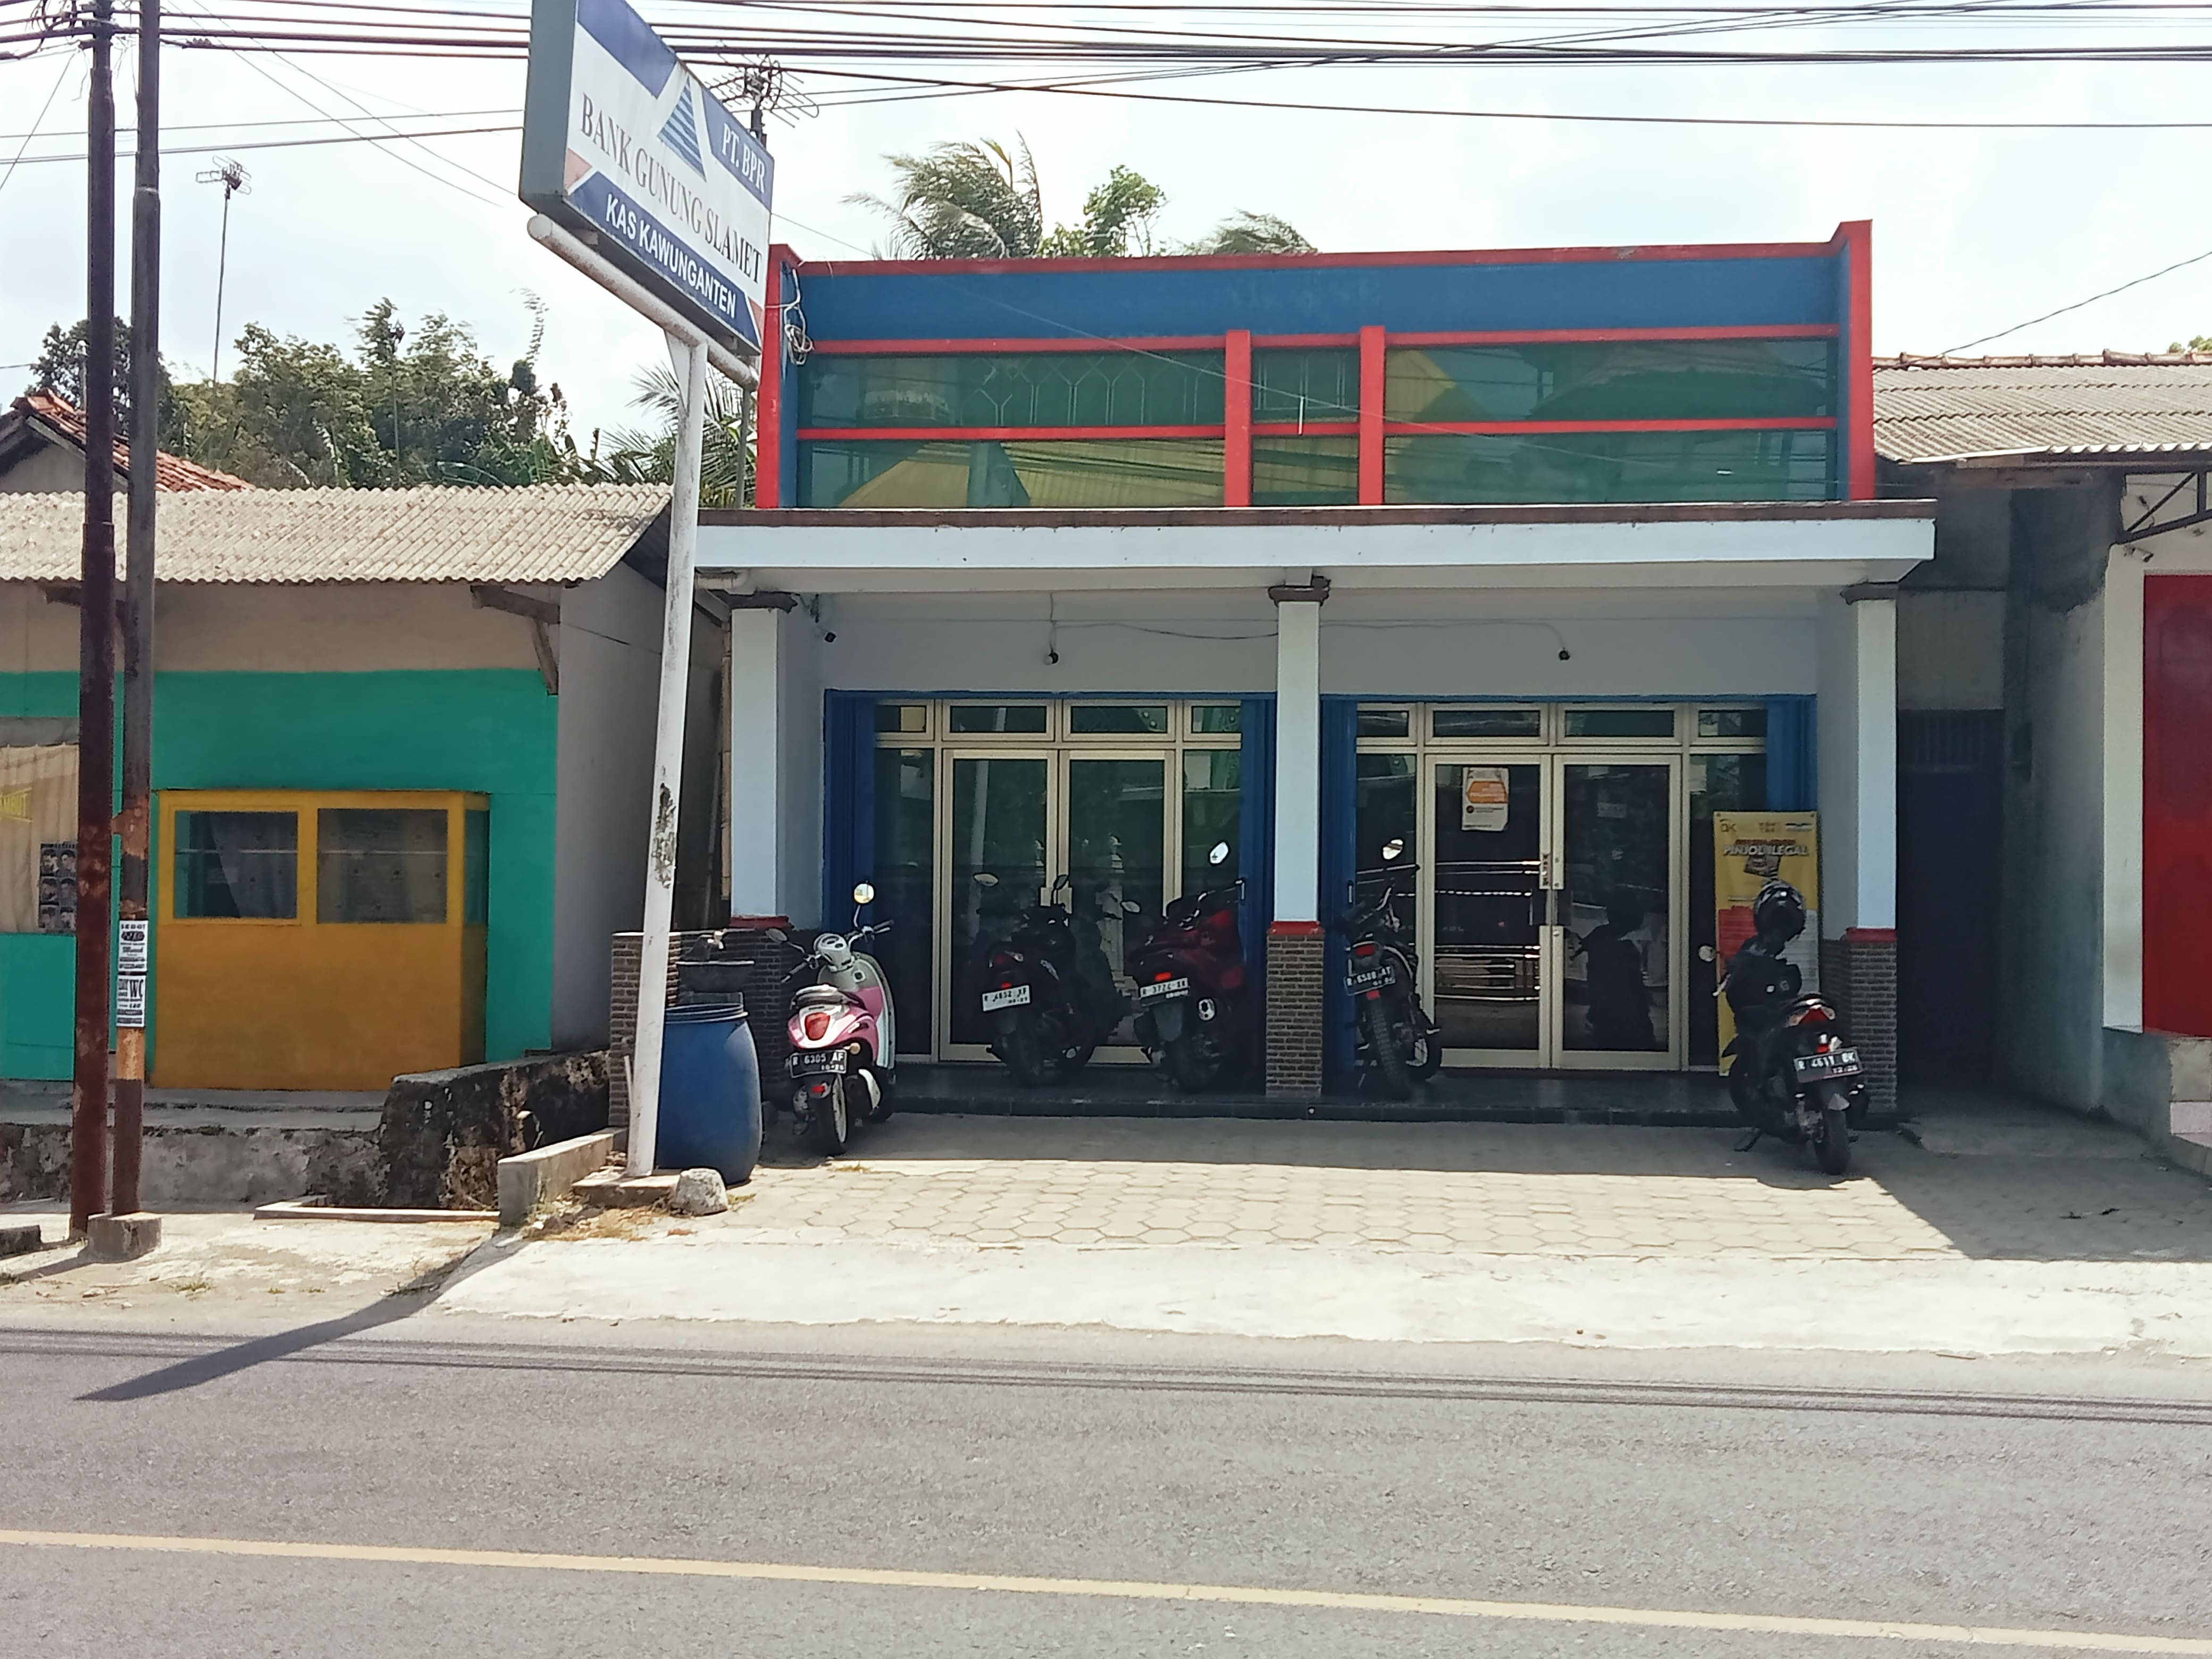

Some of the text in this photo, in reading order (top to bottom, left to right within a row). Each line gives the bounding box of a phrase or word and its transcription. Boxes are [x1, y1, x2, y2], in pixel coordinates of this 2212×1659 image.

[582, 93, 761, 284] BANK GUNUNG SLAMET
[722, 123, 766, 194] PT. BPR
[606, 193, 736, 319] KAS KAWUNGANTEN
[793, 1056, 798, 1066] R
[832, 1051, 844, 1061] AF
[1798, 1060, 1805, 1070] R
